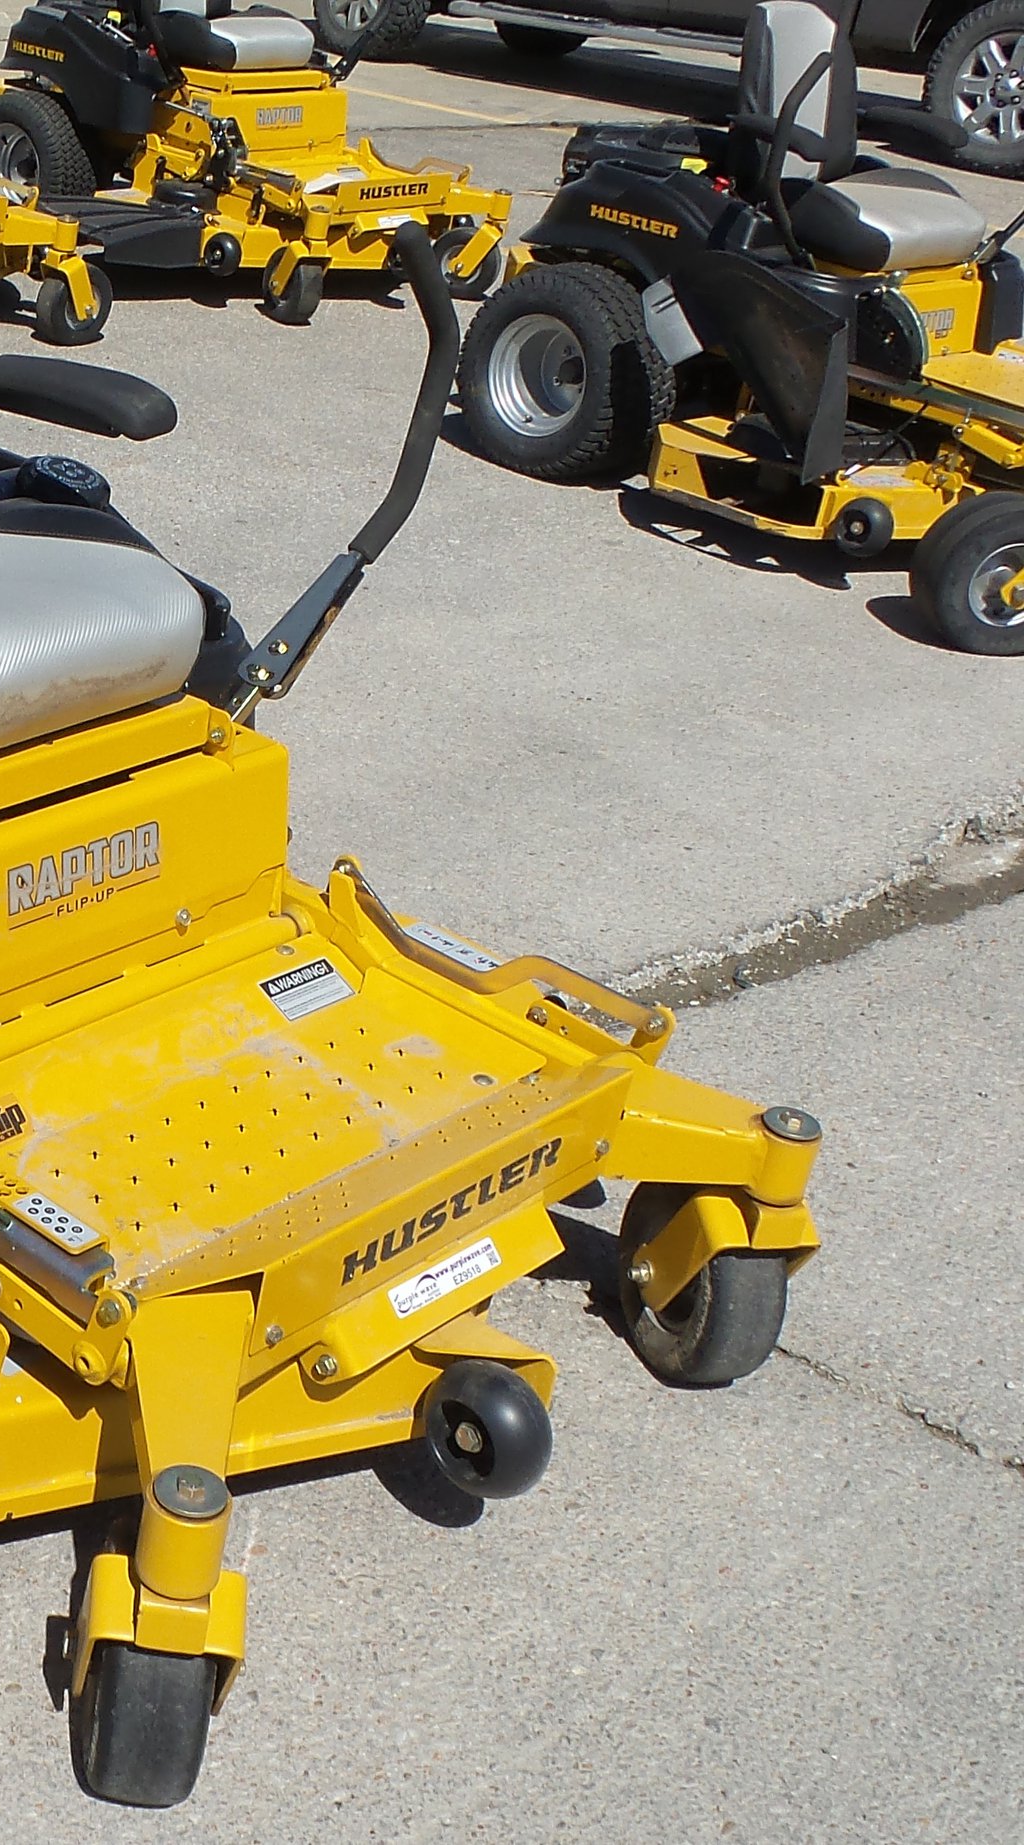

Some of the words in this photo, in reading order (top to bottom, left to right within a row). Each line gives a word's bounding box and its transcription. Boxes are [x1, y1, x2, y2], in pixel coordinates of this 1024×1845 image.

[12, 39, 65, 62] HUSTLER
[359, 182, 430, 201] HUSTLER
[589, 203, 680, 239] HUSTLER
[8, 821, 160, 916] RAPTOR
[274, 962, 330, 992] WARNING!
[341, 1137, 563, 1286] HUSTLER
[452, 1263, 482, 1286] EZ9518
[397, 1292, 419, 1310] purple
[420, 1282, 437, 1295] wave
